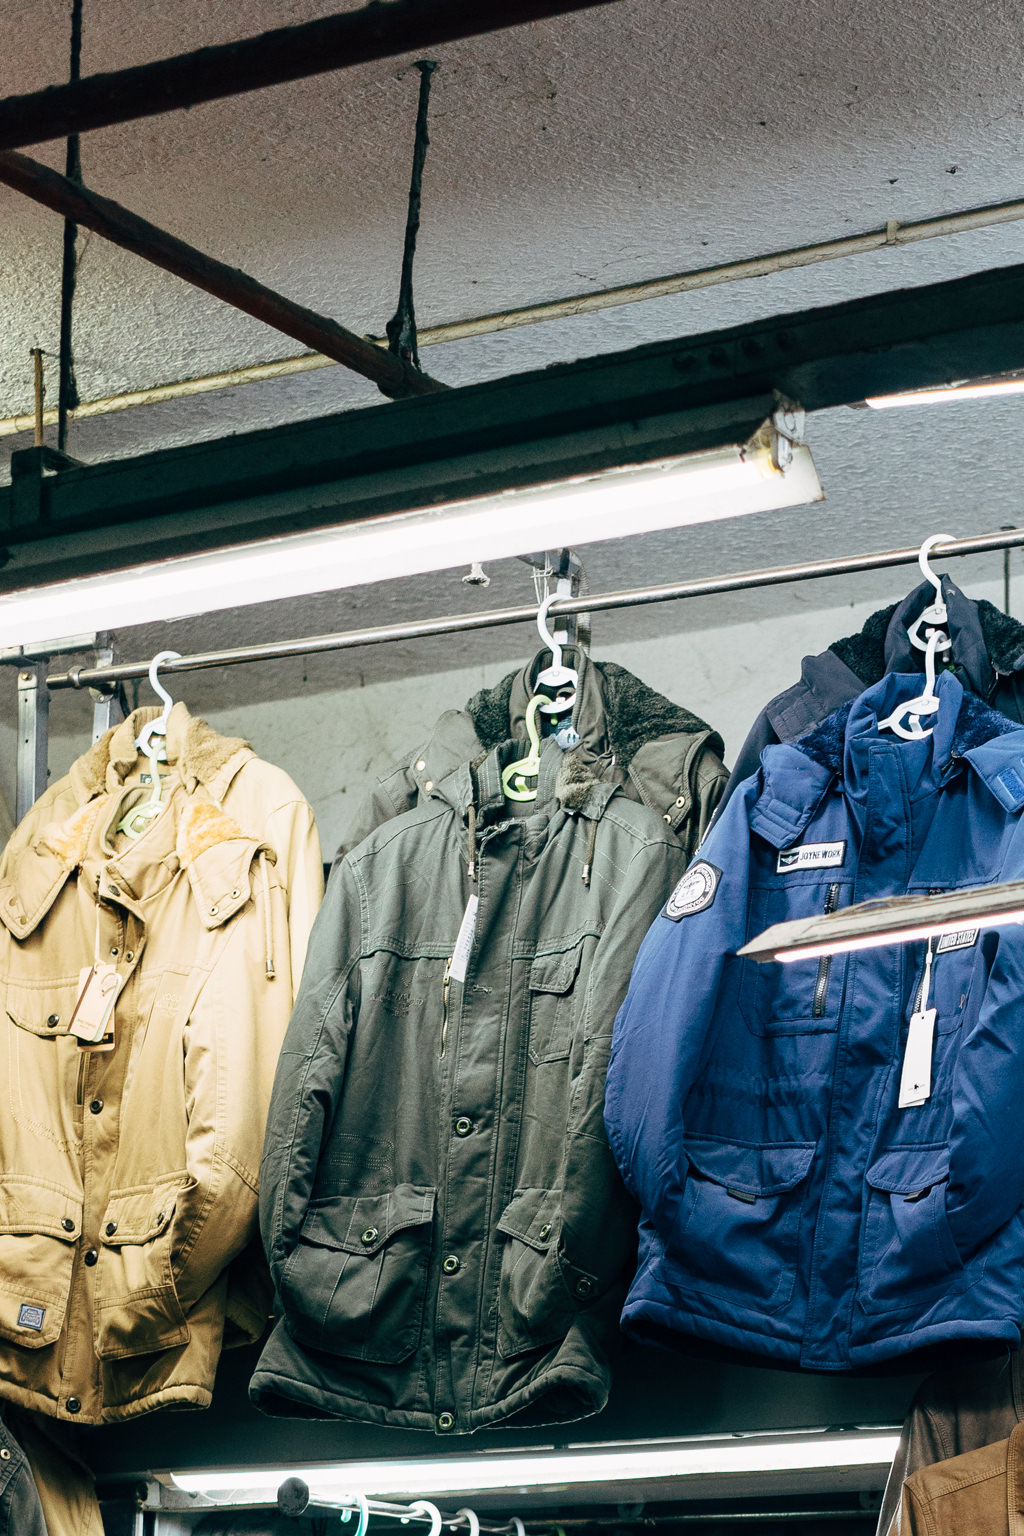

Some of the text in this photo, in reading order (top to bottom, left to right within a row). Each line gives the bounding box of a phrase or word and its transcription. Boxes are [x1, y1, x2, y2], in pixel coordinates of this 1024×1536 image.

[799, 849, 841, 861] JOYNE WORK
[957, 929, 975, 945] STATES
